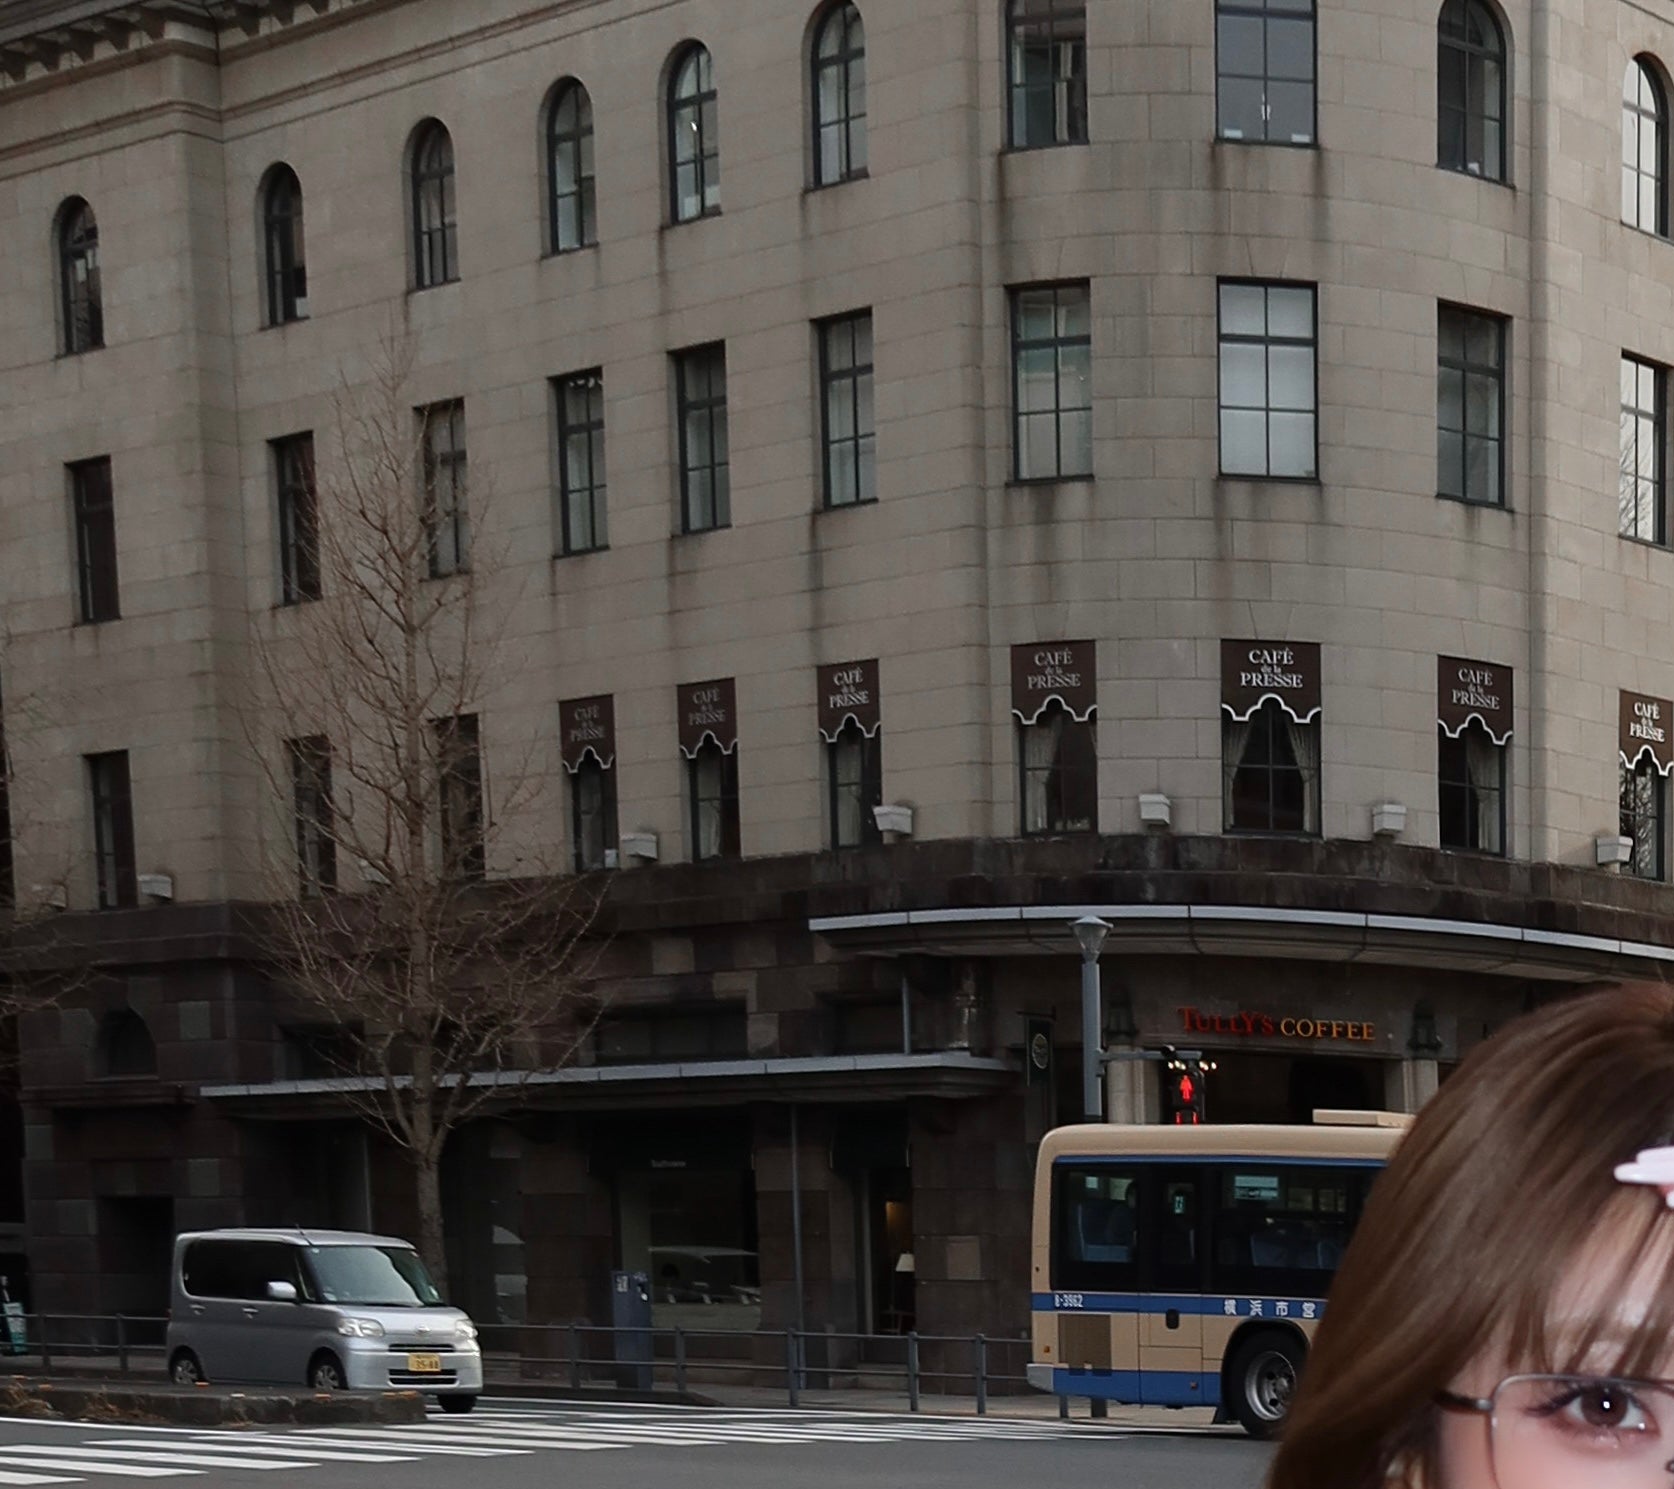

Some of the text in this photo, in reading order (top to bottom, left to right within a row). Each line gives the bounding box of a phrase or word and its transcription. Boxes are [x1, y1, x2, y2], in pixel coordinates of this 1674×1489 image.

[1034, 647, 1072, 666] CAFÉ
[1248, 647, 1293, 664] CAFÉ
[833, 667, 863, 686] CAFÉ
[1027, 672, 1080, 689] PRESSE
[1240, 671, 1302, 687] PRESSE
[1457, 667, 1492, 686] CAFÉ
[829, 690, 869, 708] PRESSE
[1451, 688, 1499, 710] PRESSE
[1633, 701, 1660, 720] CAFÉ
[1629, 721, 1665, 743] PRESSE
[1279, 1016, 1376, 1040] COFFEE
